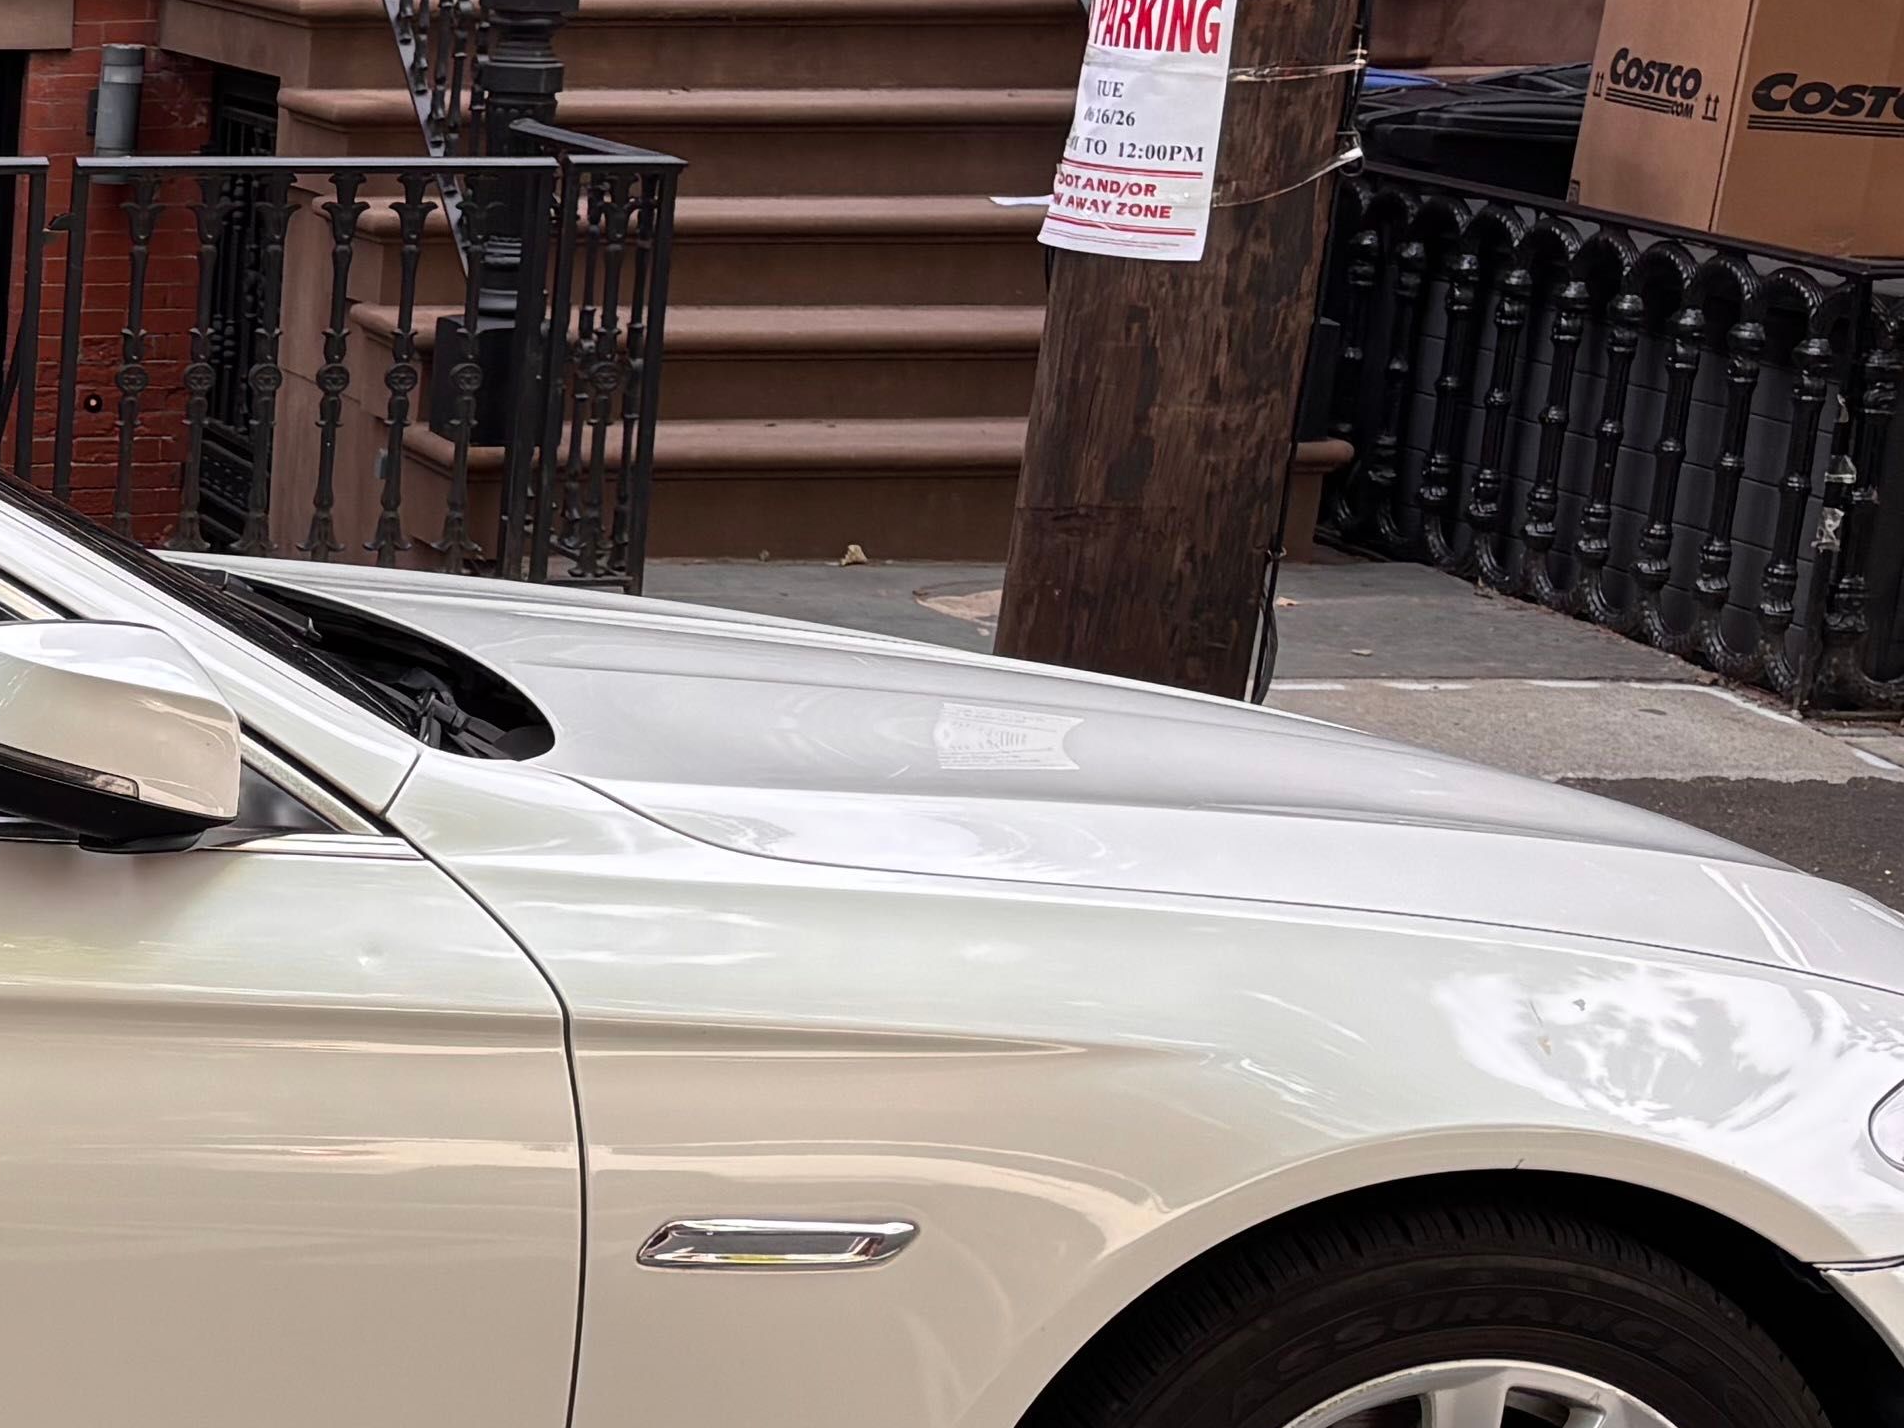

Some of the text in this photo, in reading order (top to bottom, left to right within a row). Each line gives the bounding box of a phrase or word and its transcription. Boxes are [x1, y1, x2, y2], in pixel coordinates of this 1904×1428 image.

[1085, 137, 1107, 155] TO
[1118, 142, 1205, 163] 12:00PM
[1081, 176, 1158, 198] AND/OR
[1065, 193, 1113, 215] AWAY
[1116, 202, 1174, 219] ZONE
